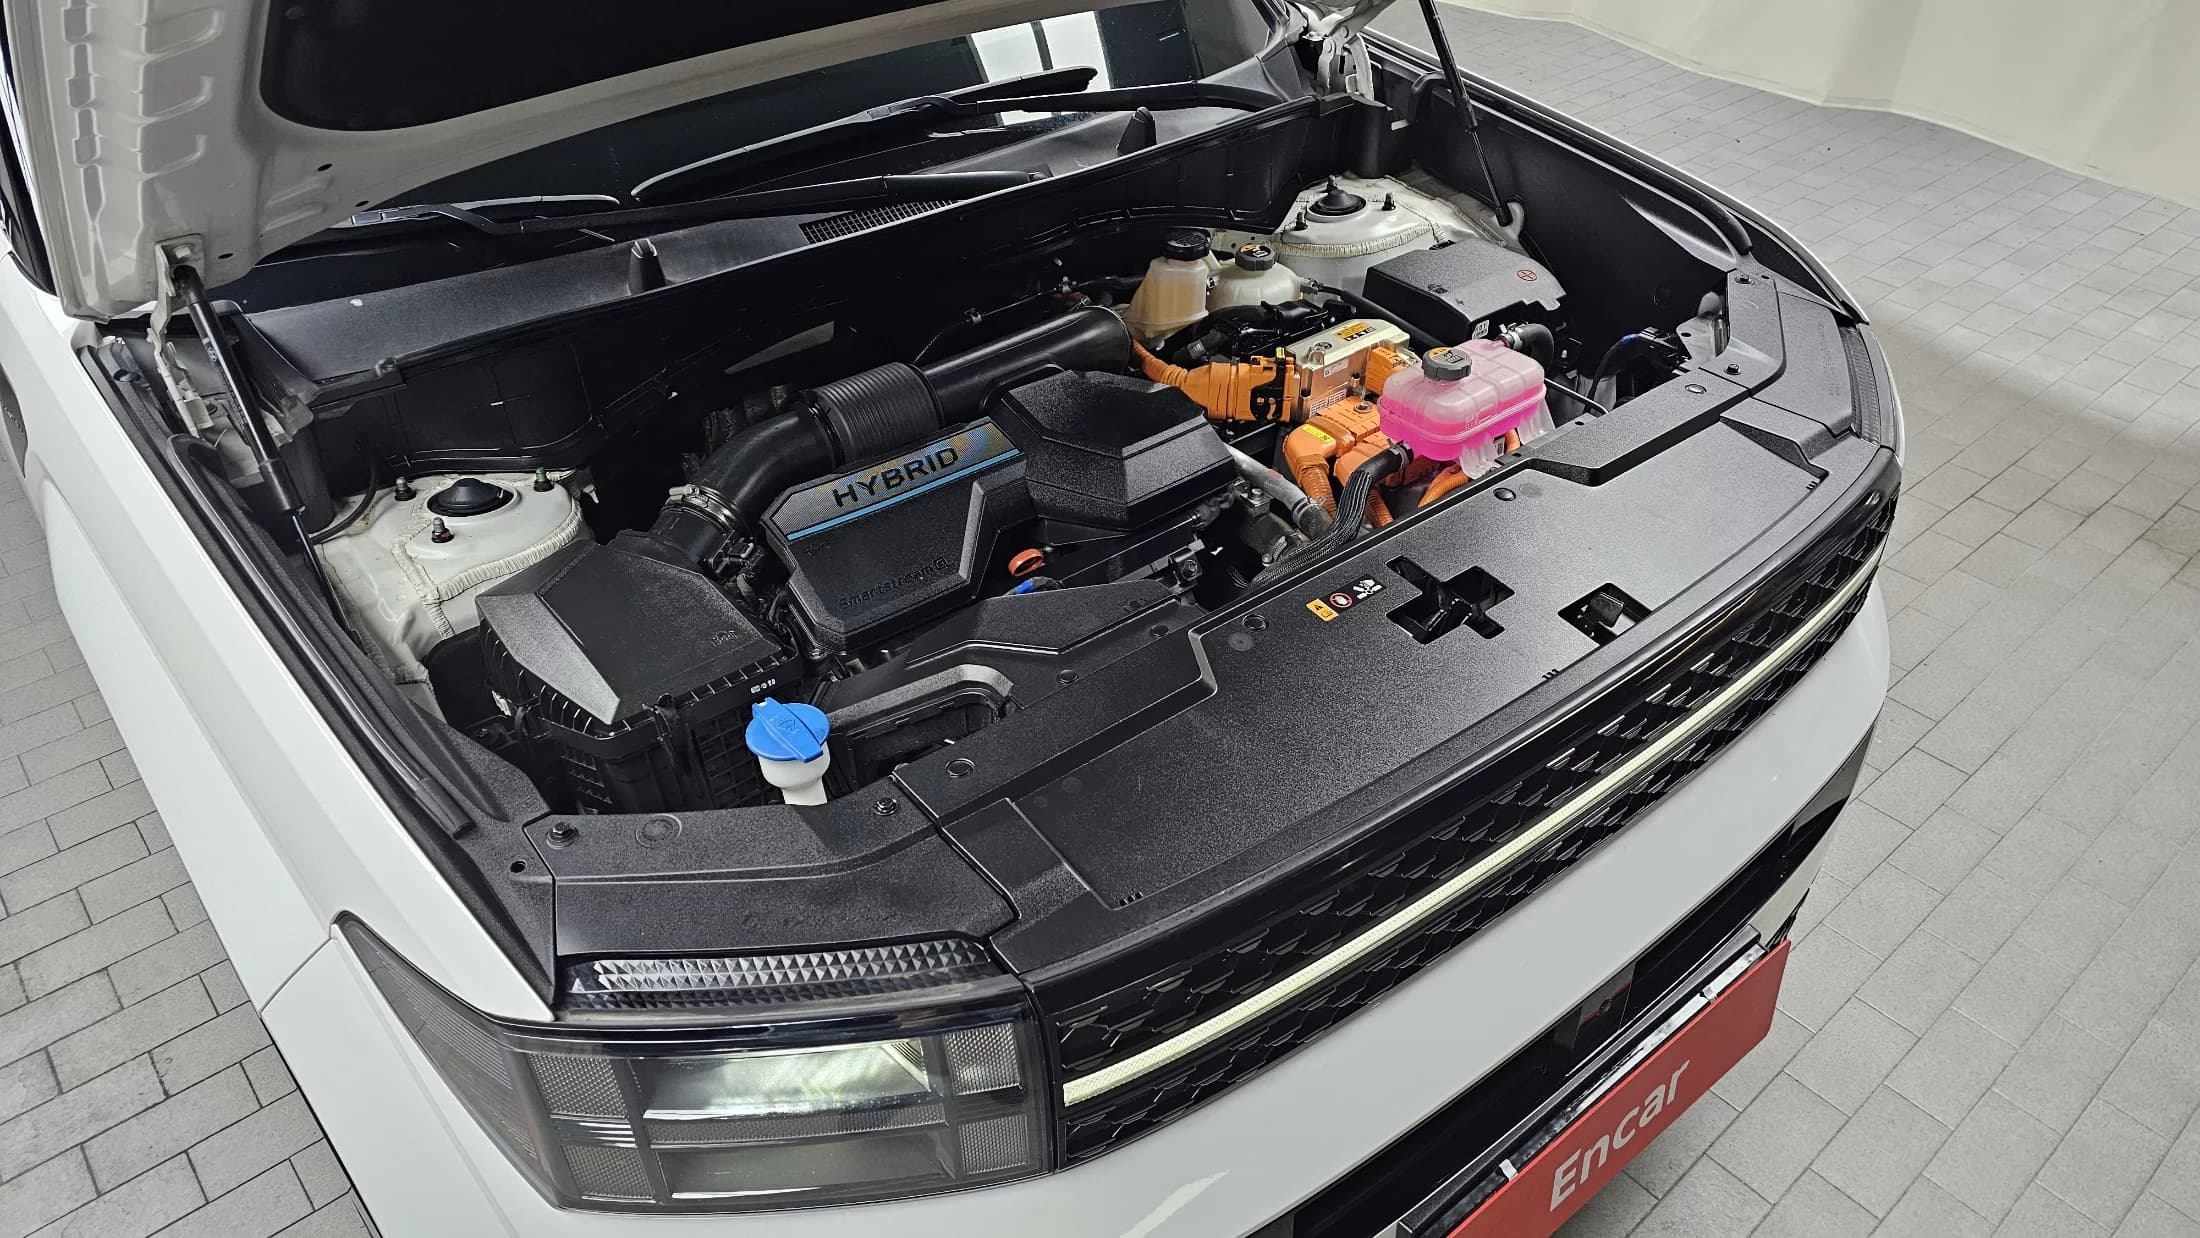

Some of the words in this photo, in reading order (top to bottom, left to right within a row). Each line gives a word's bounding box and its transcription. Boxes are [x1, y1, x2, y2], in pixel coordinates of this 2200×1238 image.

[832, 447, 959, 507] HYBRID
[838, 563, 934, 610] Smartstream
[1550, 1060, 1690, 1212] Encar
